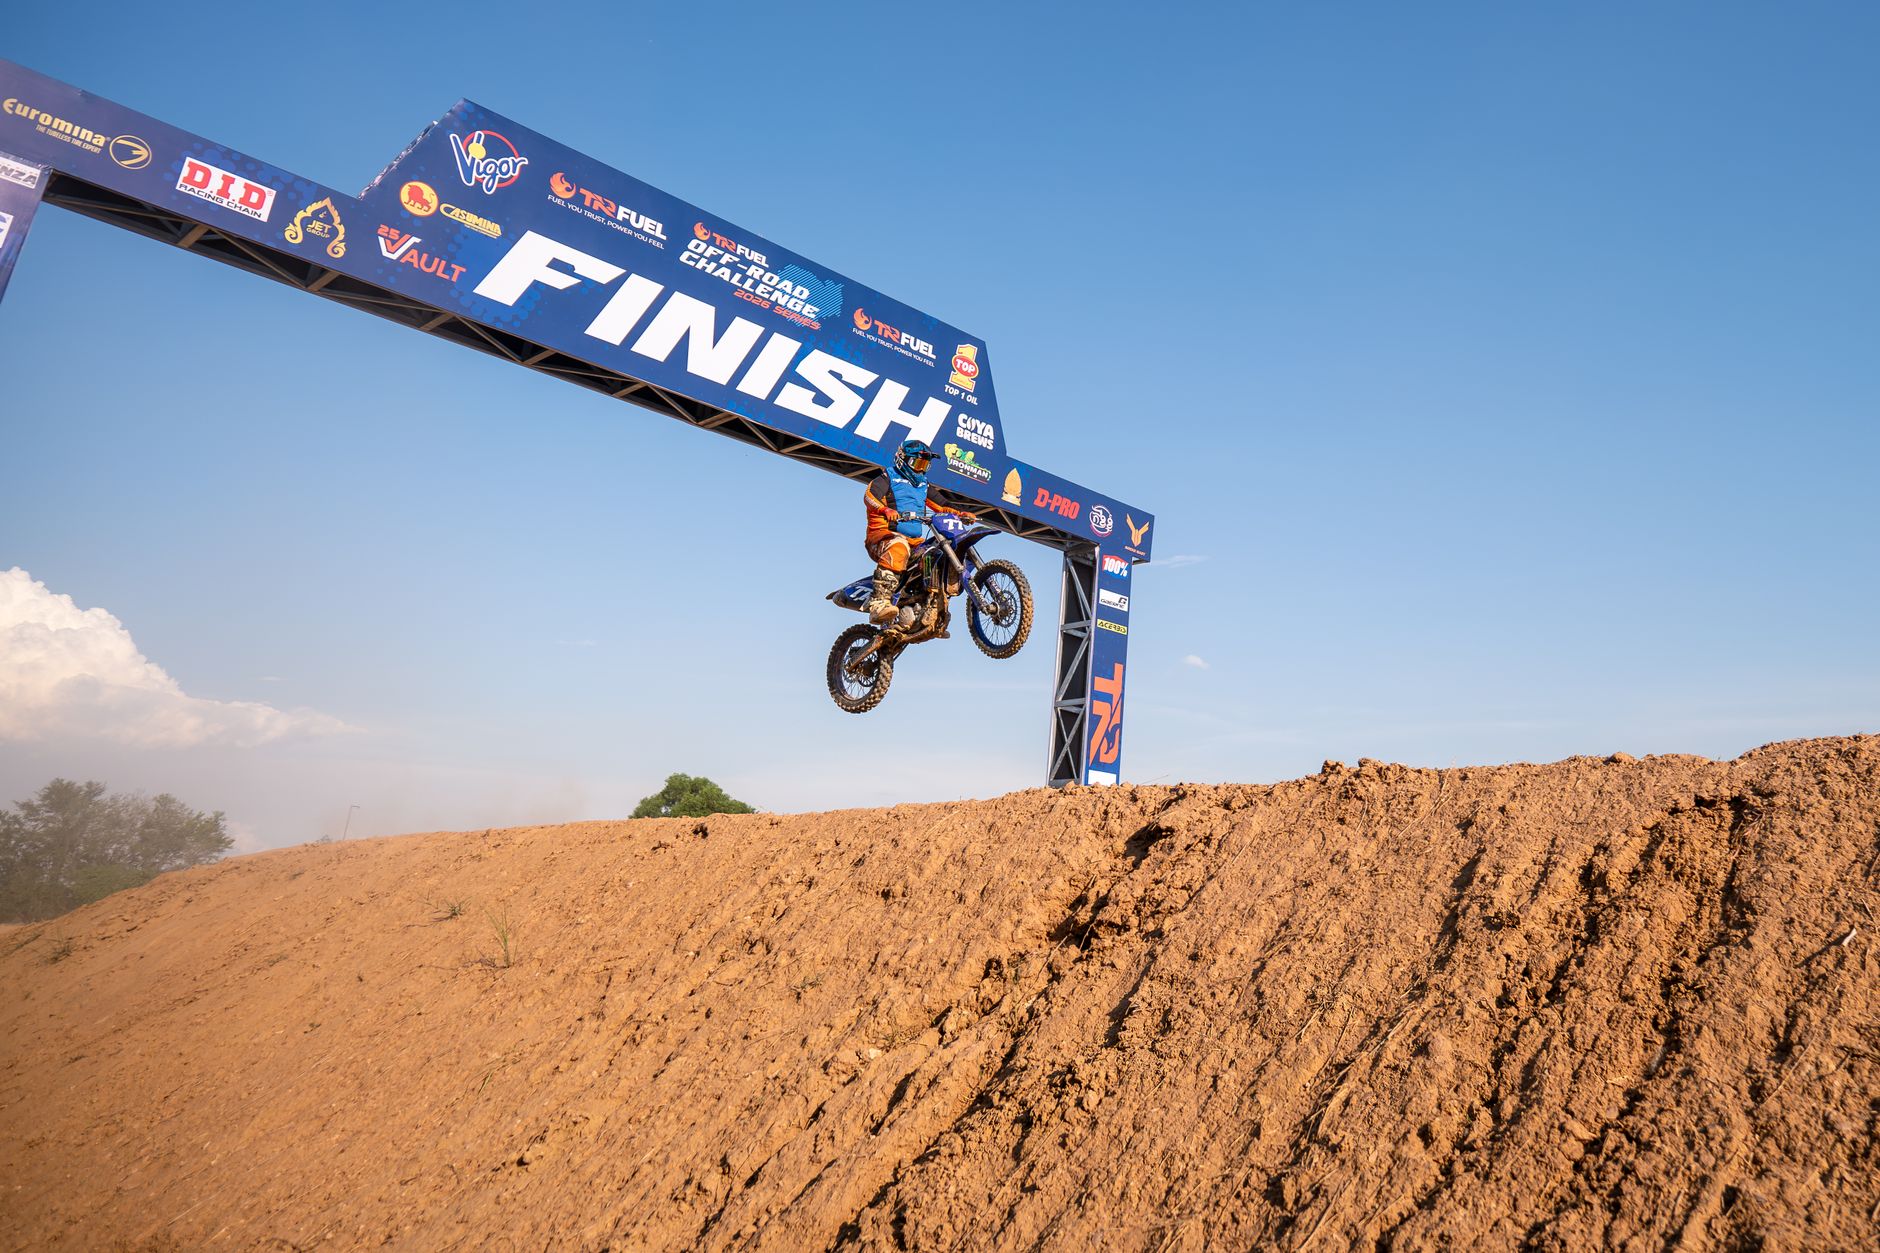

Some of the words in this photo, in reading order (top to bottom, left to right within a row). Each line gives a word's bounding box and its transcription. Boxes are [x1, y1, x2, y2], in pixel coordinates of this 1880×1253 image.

[449, 131, 529, 195] Vigor
[179, 183, 224, 204] RACING
[226, 199, 262, 218] CHAIN
[307, 219, 332, 233] JET
[547, 194, 567, 207] FUEL
[567, 202, 583, 214] YOU
[607, 220, 633, 236] POWER
[633, 232, 648, 242] YOU
[648, 238, 665, 250] FEEL
[679, 250, 820, 318] CHALLENGE
[687, 238, 810, 300] OFF-ROAD
[733, 288, 772, 309] 2026
[773, 305, 822, 331] SERIES
[472, 230, 952, 447] FINISH
[852, 327, 866, 338] FUEL
[866, 333, 878, 342] YOU
[894, 345, 912, 357] POWER
[912, 353, 923, 362] YOU
[923, 358, 935, 368] FEEL
[955, 358, 976, 374] TOP
[944, 384, 960, 396] TOP
[960, 391, 966, 400] 1
[966, 394, 979, 406] OIL
[956, 426, 994, 450] BREWS
[949, 458, 989, 479] IRONMAN
[1033, 487, 1080, 520] D-PRO
[1103, 556, 1129, 577] 100%
